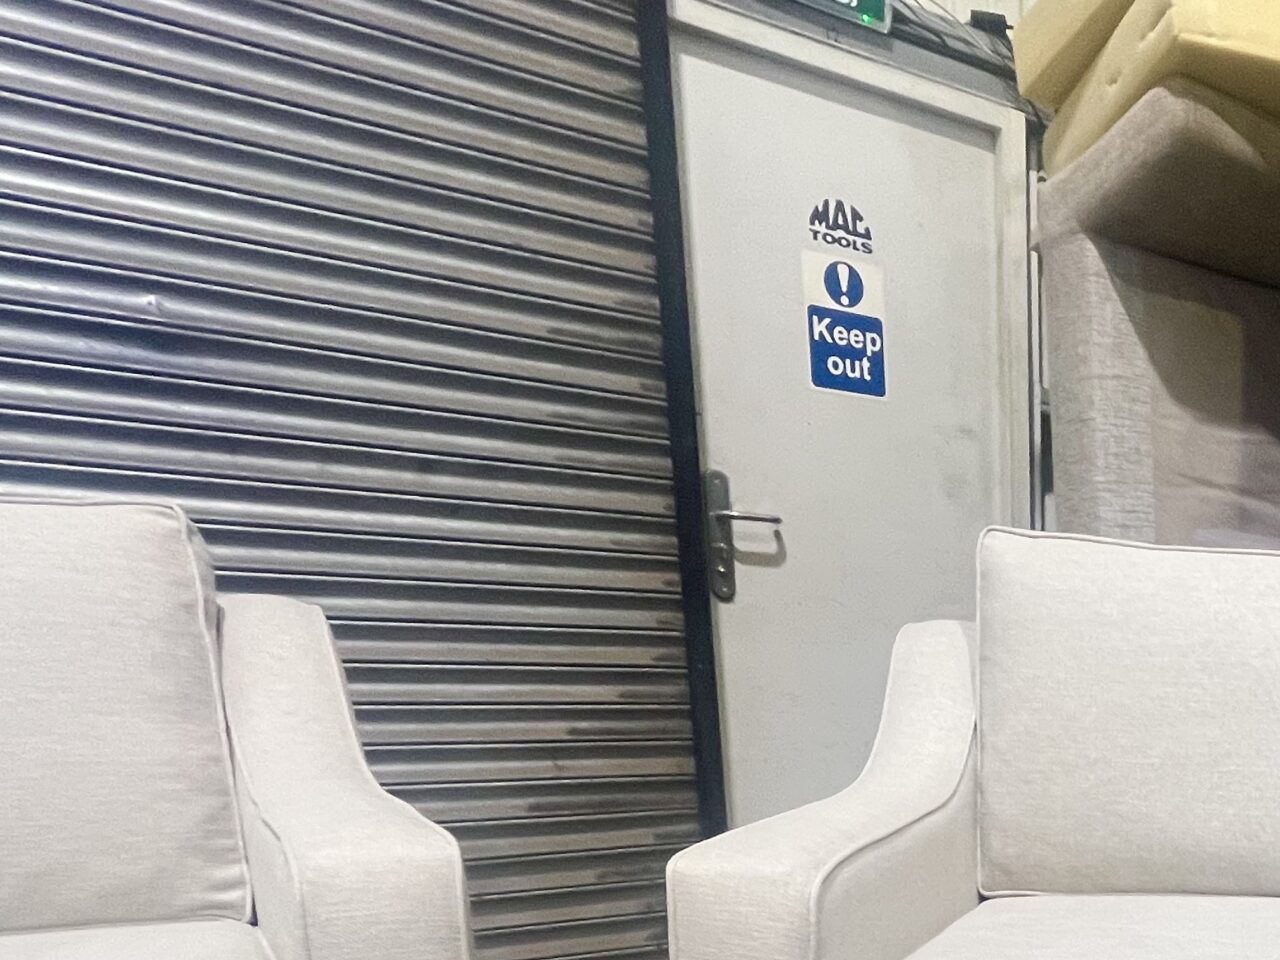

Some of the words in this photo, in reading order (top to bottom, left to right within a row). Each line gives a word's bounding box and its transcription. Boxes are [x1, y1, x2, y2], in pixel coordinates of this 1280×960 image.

[809, 199, 872, 241] MAC
[809, 228, 873, 254] TOOLS
[812, 315, 882, 356] Keep
[826, 355, 872, 381] out
